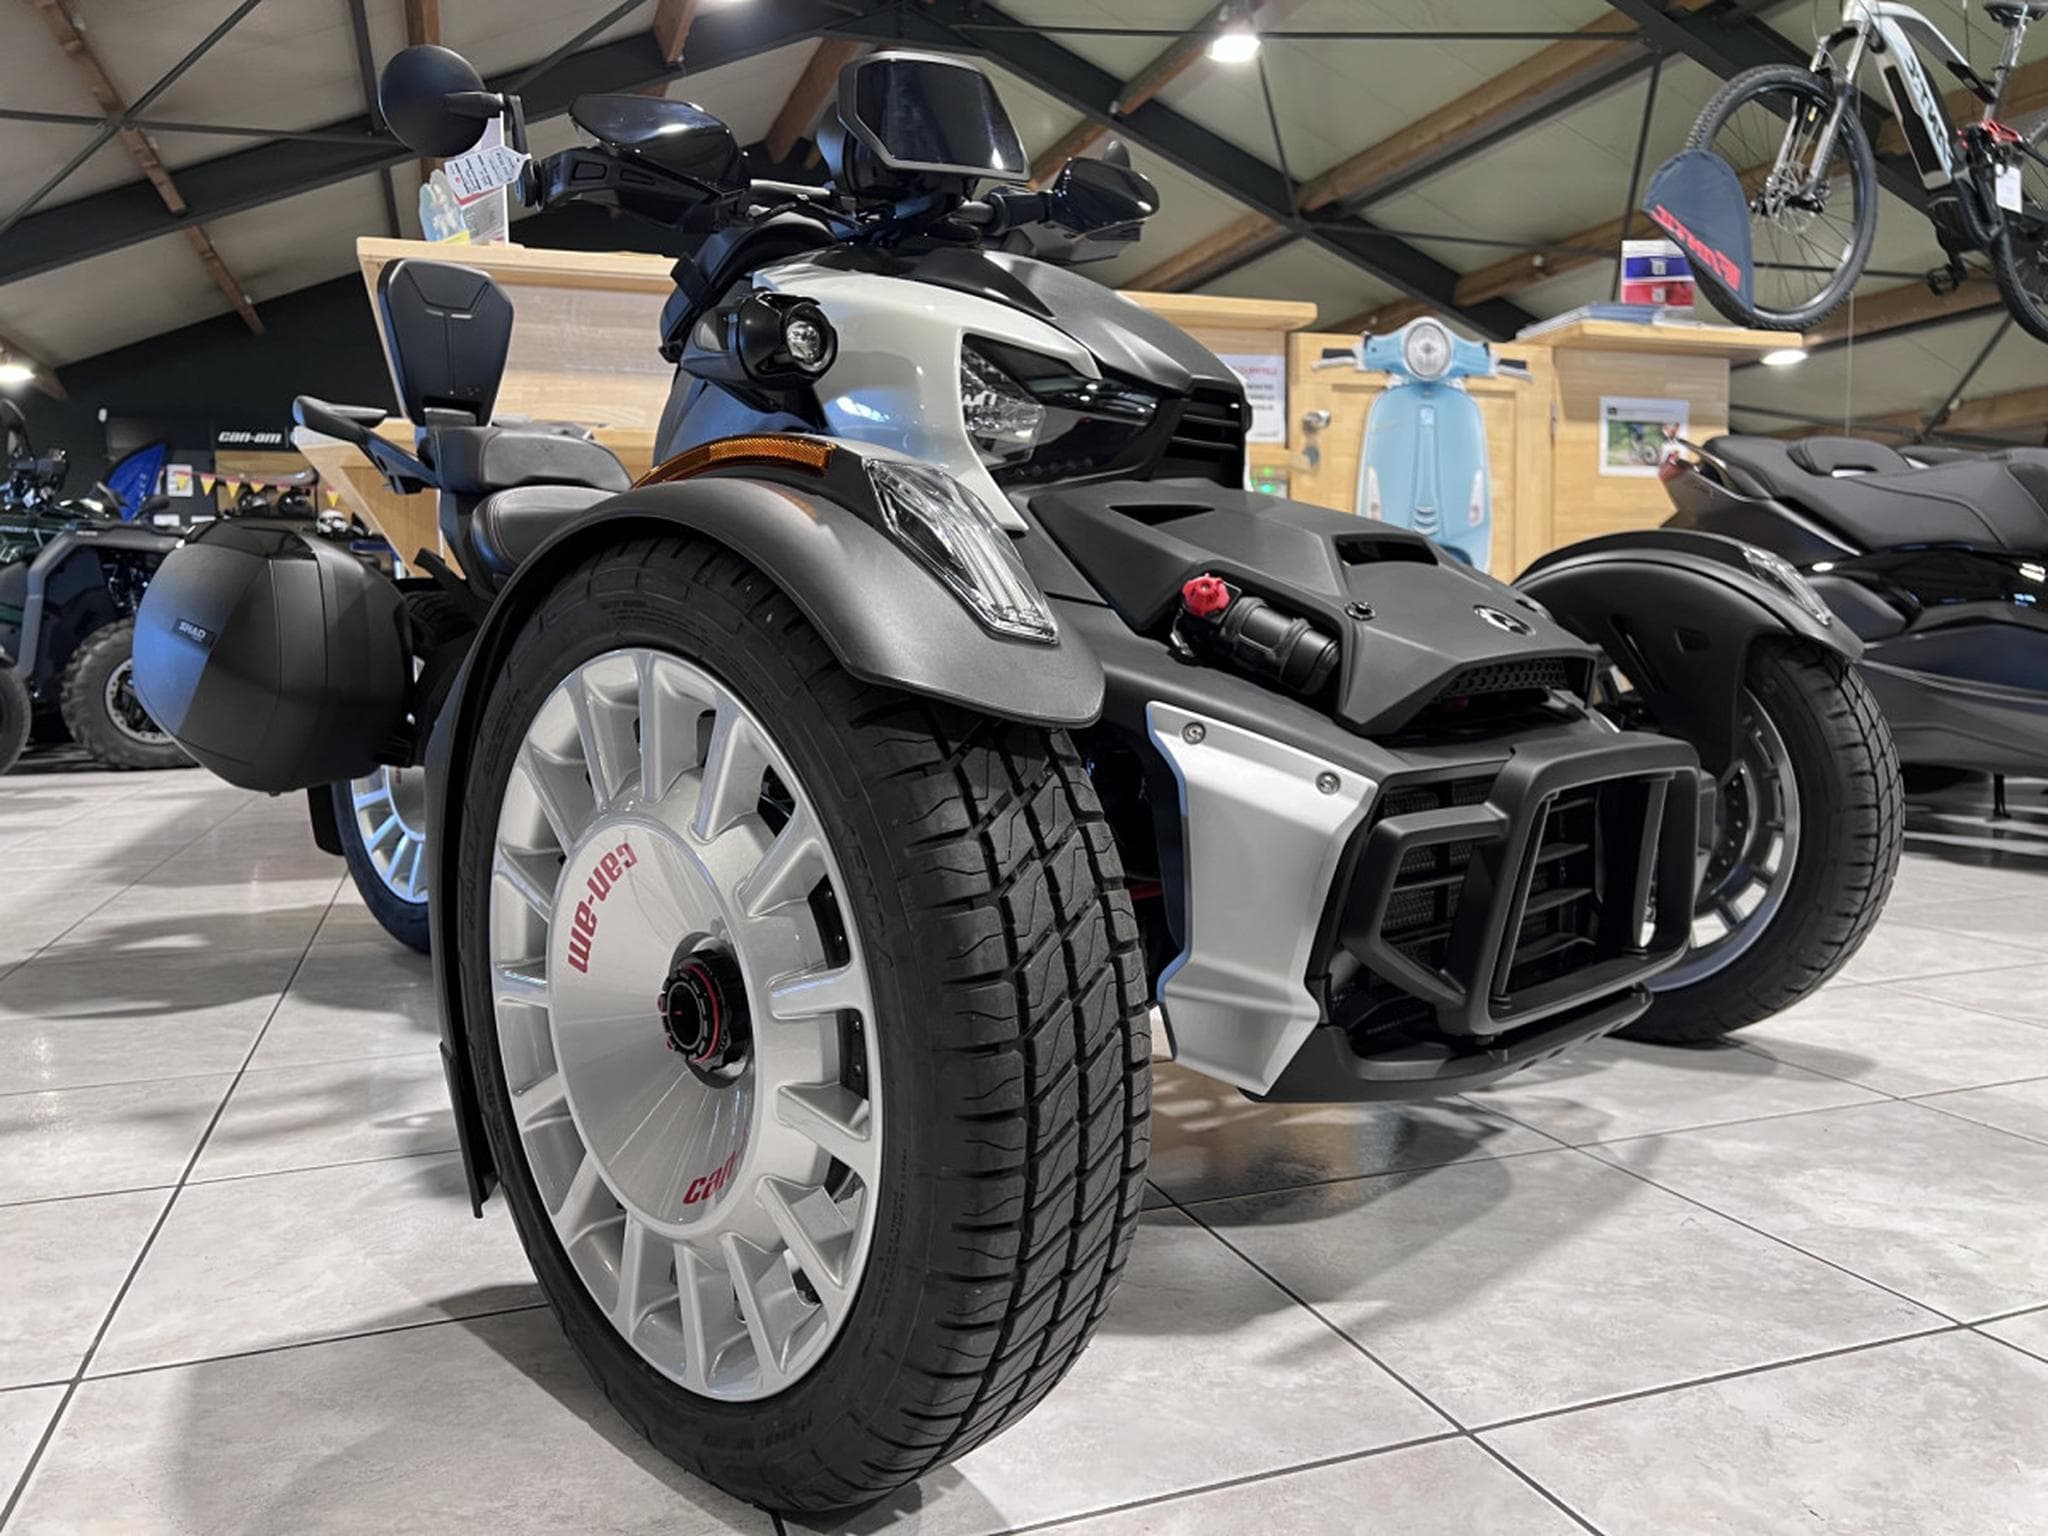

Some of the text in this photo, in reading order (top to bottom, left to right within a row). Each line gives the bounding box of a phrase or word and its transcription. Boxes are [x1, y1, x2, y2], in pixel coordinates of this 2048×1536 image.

[218, 431, 282, 443] can-am
[179, 621, 207, 639] SHAD
[568, 842, 638, 973] can-am
